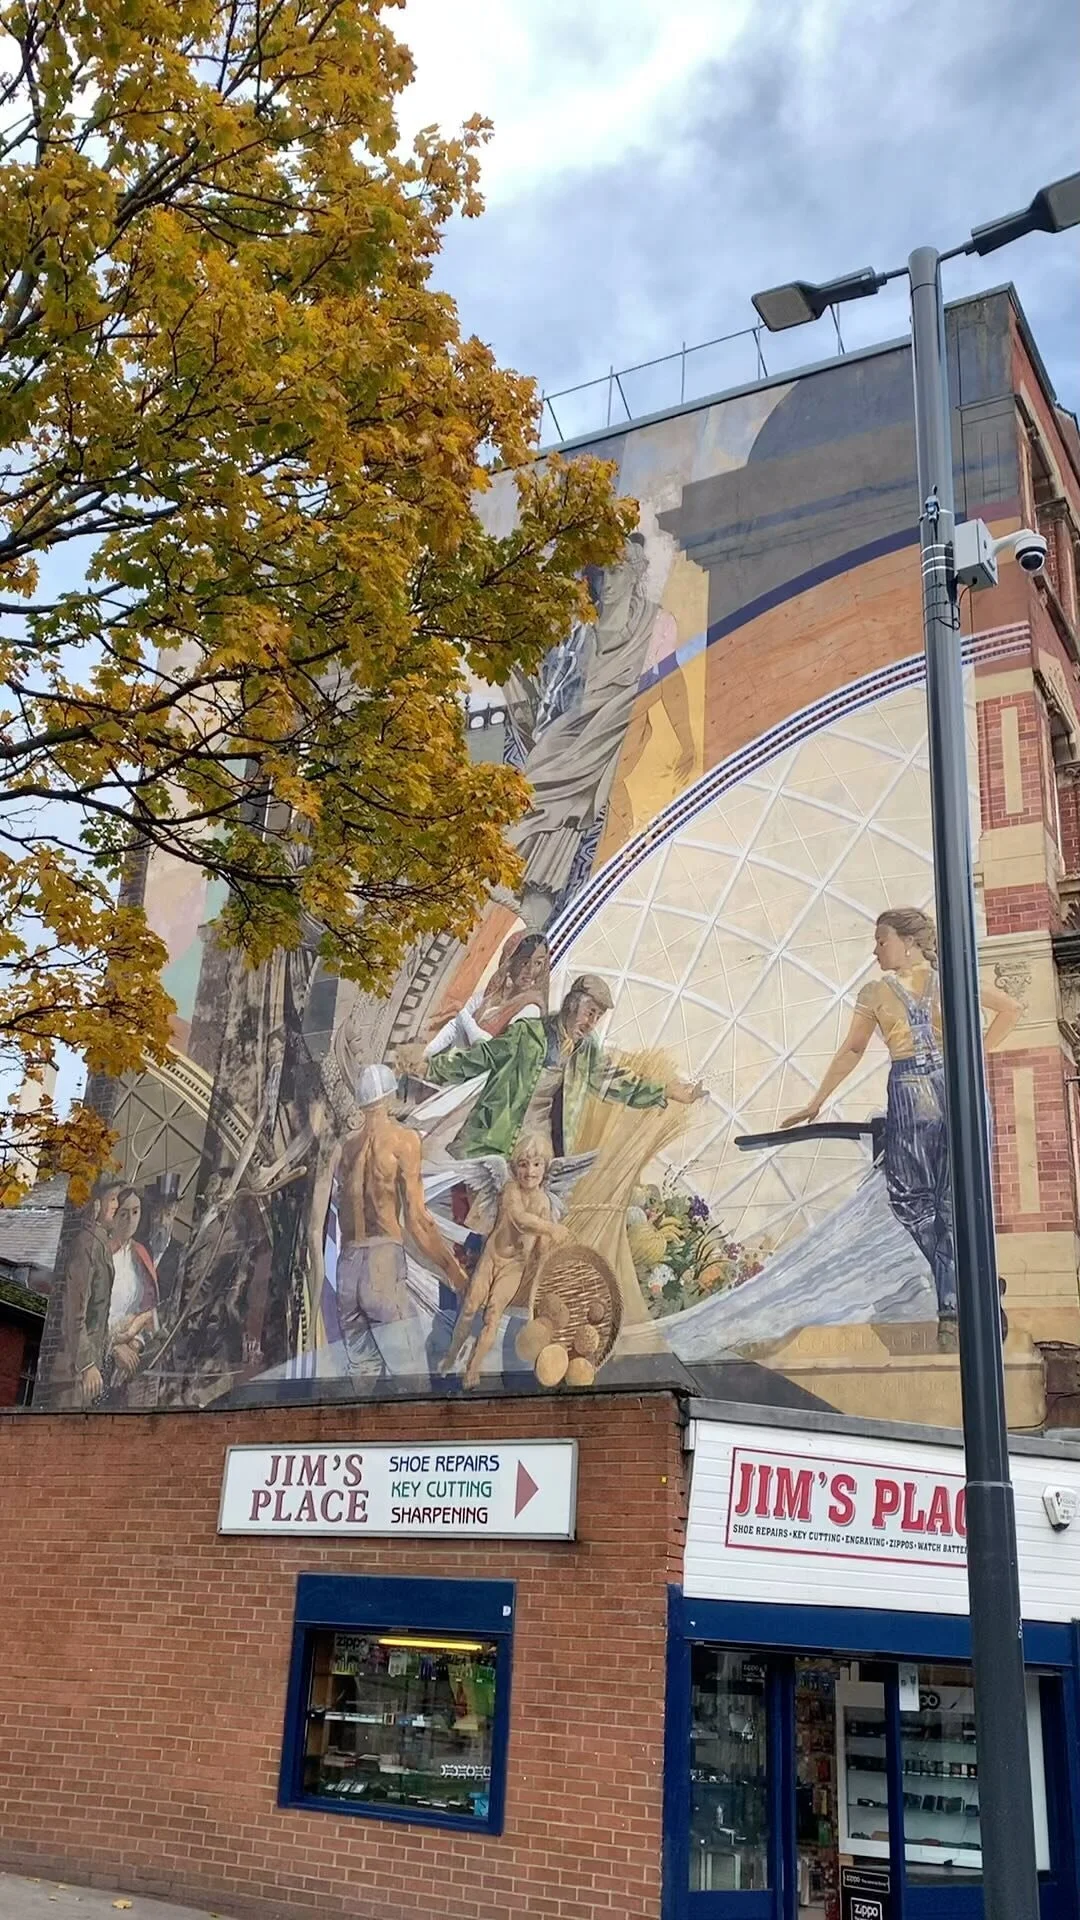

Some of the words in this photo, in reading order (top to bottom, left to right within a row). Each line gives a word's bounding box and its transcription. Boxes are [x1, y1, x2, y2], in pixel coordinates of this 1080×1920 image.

[264, 1453, 364, 1487] JIM'S
[389, 1455, 431, 1472] SHOE
[435, 1455, 500, 1472] REPAIRS
[391, 1481, 423, 1498] KEY
[426, 1481, 492, 1498] CUTTING
[734, 1462, 858, 1527] JIM'S
[249, 1489, 370, 1523] PLACE
[391, 1507, 488, 1525] SHARPENING
[733, 1524, 754, 1535] SHOE
[756, 1527, 789, 1538] REPAIRS
[792, 1530, 807, 1540] KEY
[809, 1532, 841, 1543] CUTTING
[845, 1535, 886, 1547] ENGRAVING
[889, 1539, 914, 1550] ZIPPOS
[918, 1542, 941, 1552] WATCH
